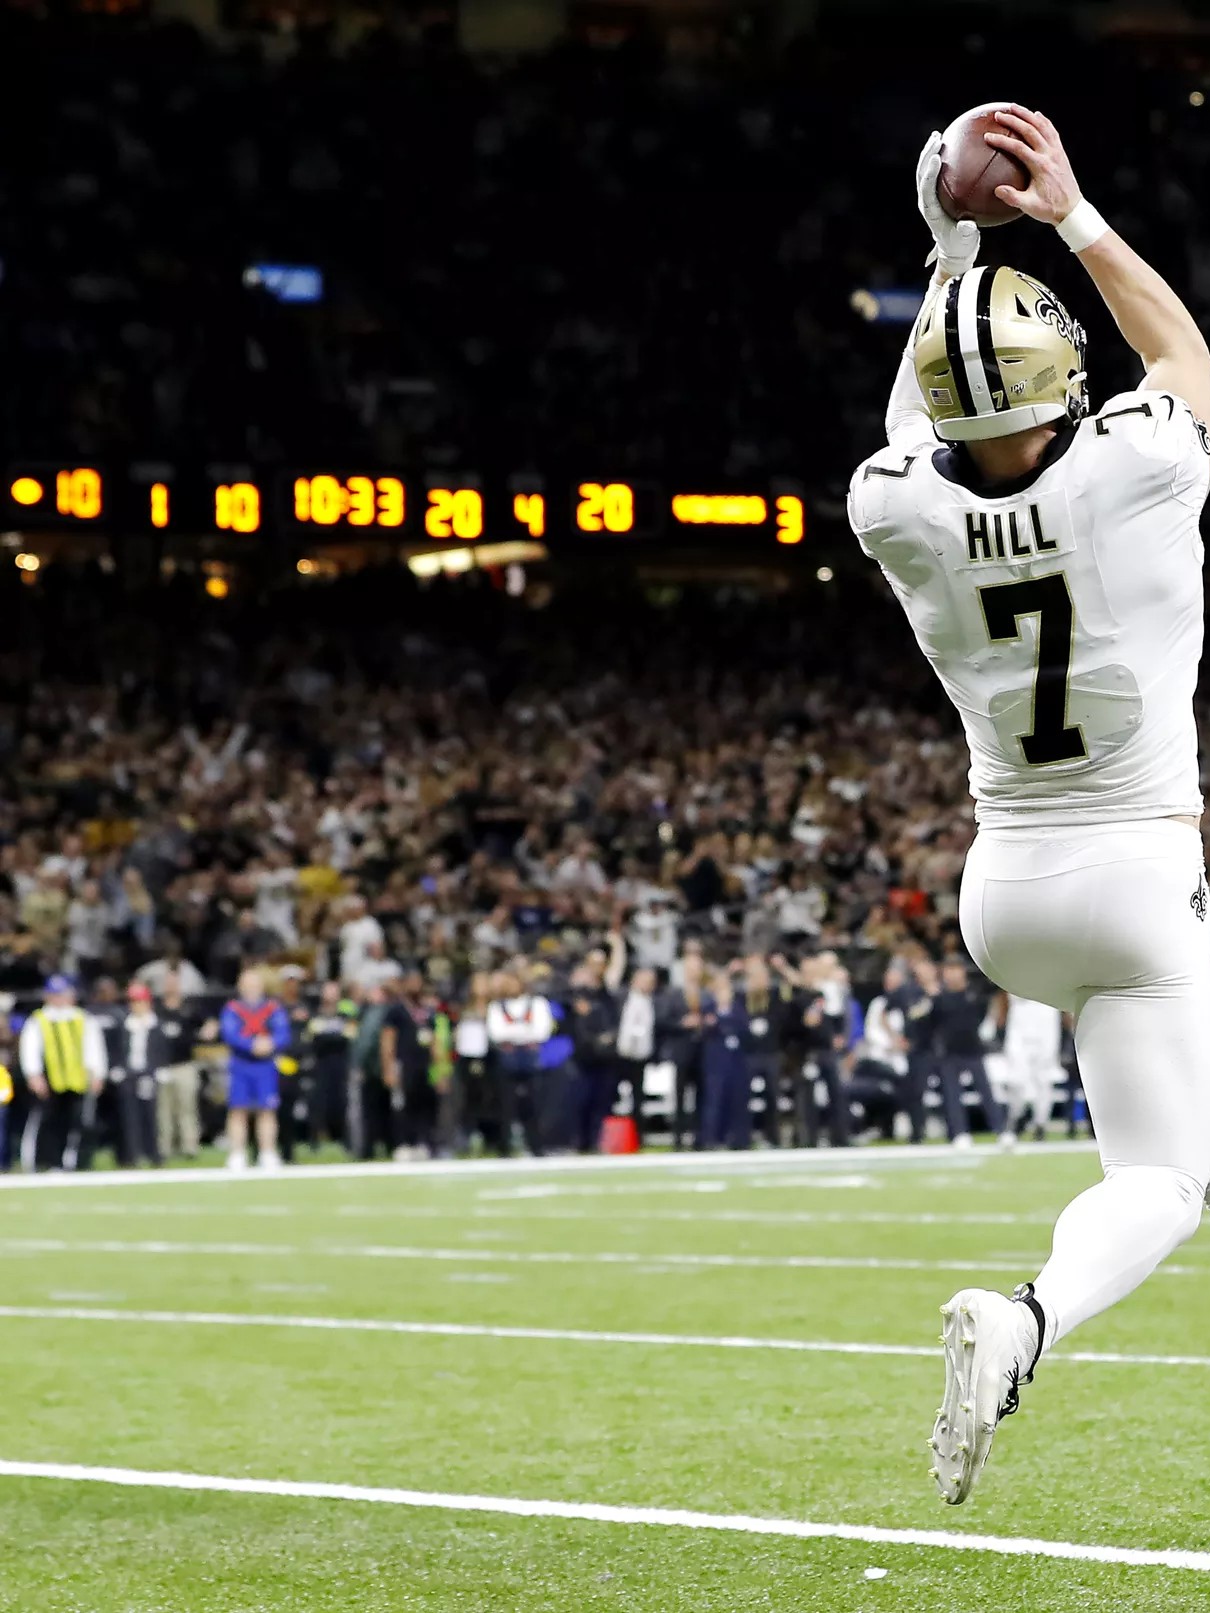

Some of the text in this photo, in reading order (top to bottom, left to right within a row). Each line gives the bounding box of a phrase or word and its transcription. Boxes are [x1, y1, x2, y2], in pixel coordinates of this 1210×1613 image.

[991, 390, 1004, 409] 7
[1093, 402, 1154, 438] 7
[56, 468, 102, 519] 10
[862, 455, 918, 483] 7
[151, 483, 169, 528] 1
[215, 482, 260, 533] 10
[294, 475, 405, 527] 10:33
[424, 488, 483, 539] 20
[513, 493, 545, 537] 4
[576, 482, 634, 533] 20
[775, 495, 804, 544] 3
[965, 502, 1060, 562] HILL
[976, 570, 1090, 767] 7
